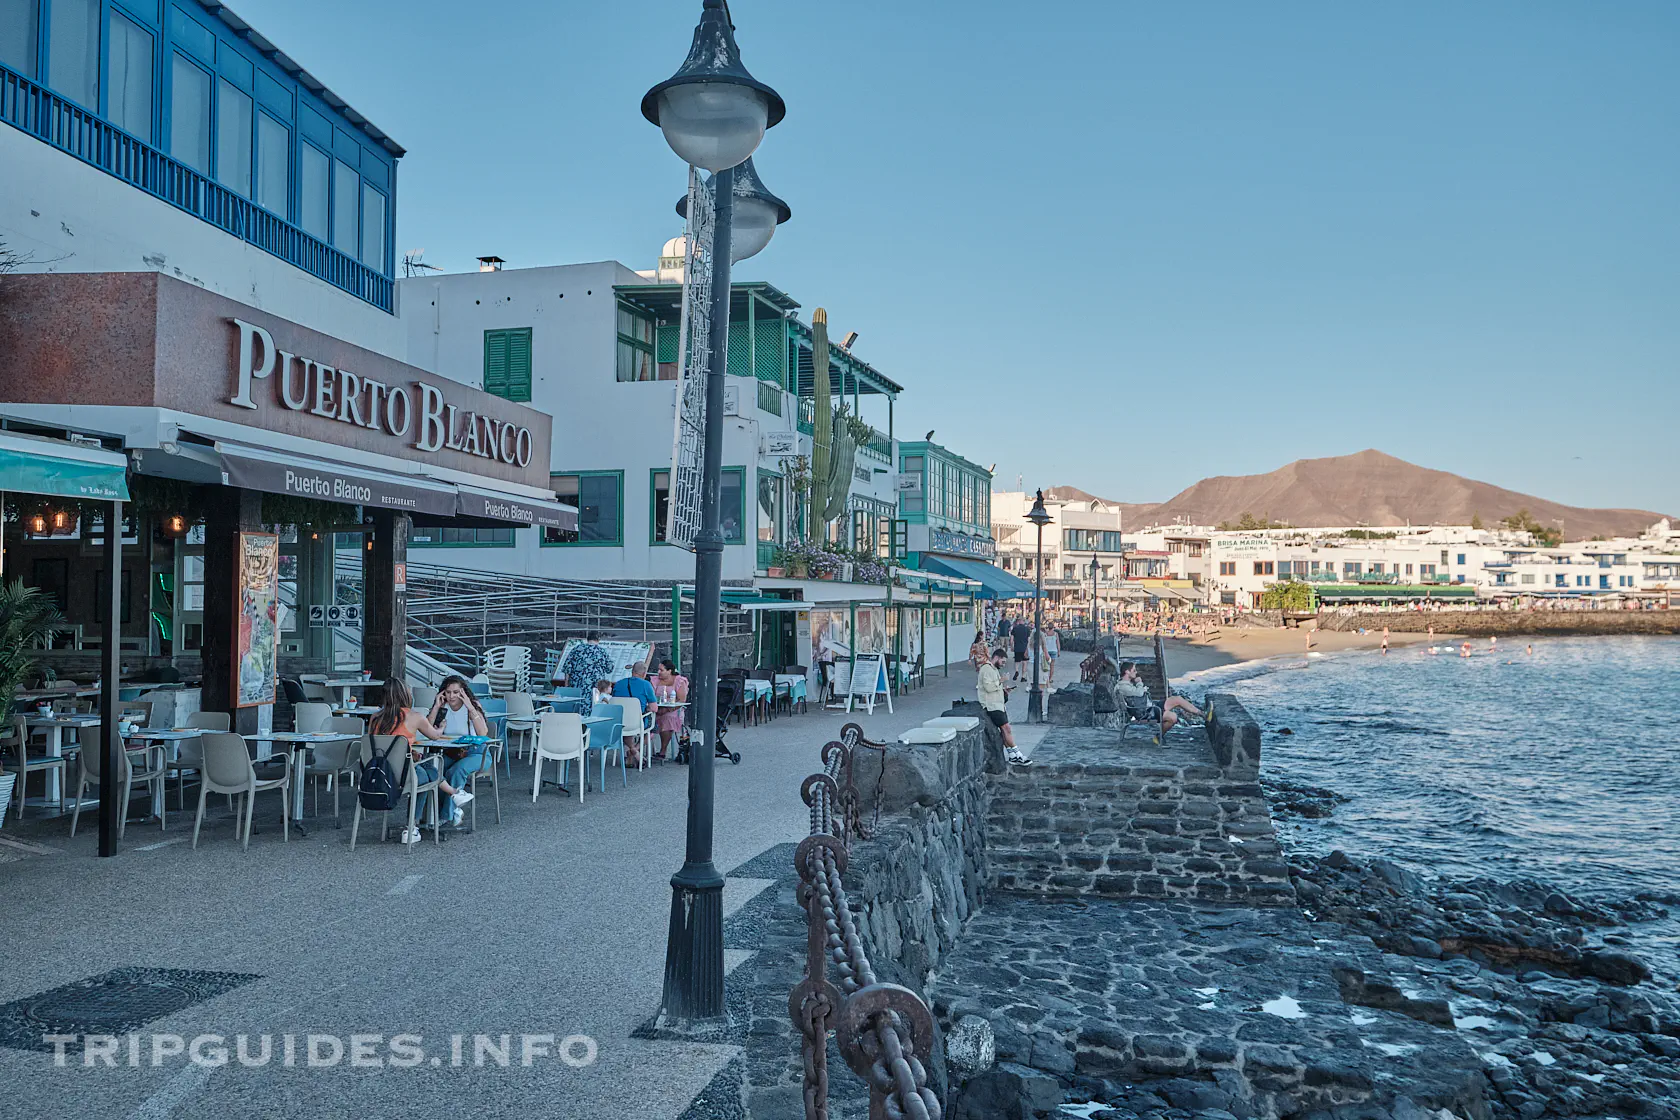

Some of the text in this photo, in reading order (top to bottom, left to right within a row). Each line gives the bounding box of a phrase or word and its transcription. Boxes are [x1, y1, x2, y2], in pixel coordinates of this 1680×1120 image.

[230, 317, 533, 468] PUERTO BLANCO
[285, 470, 416, 507] Puerto Blanco RESTAURANTE
[484, 500, 510, 519] Puerto
[511, 504, 533, 522] Blanco
[245, 544, 273, 557] Blanco
[253, 538, 273, 547] Puerto
[396, 567, 403, 582] R
